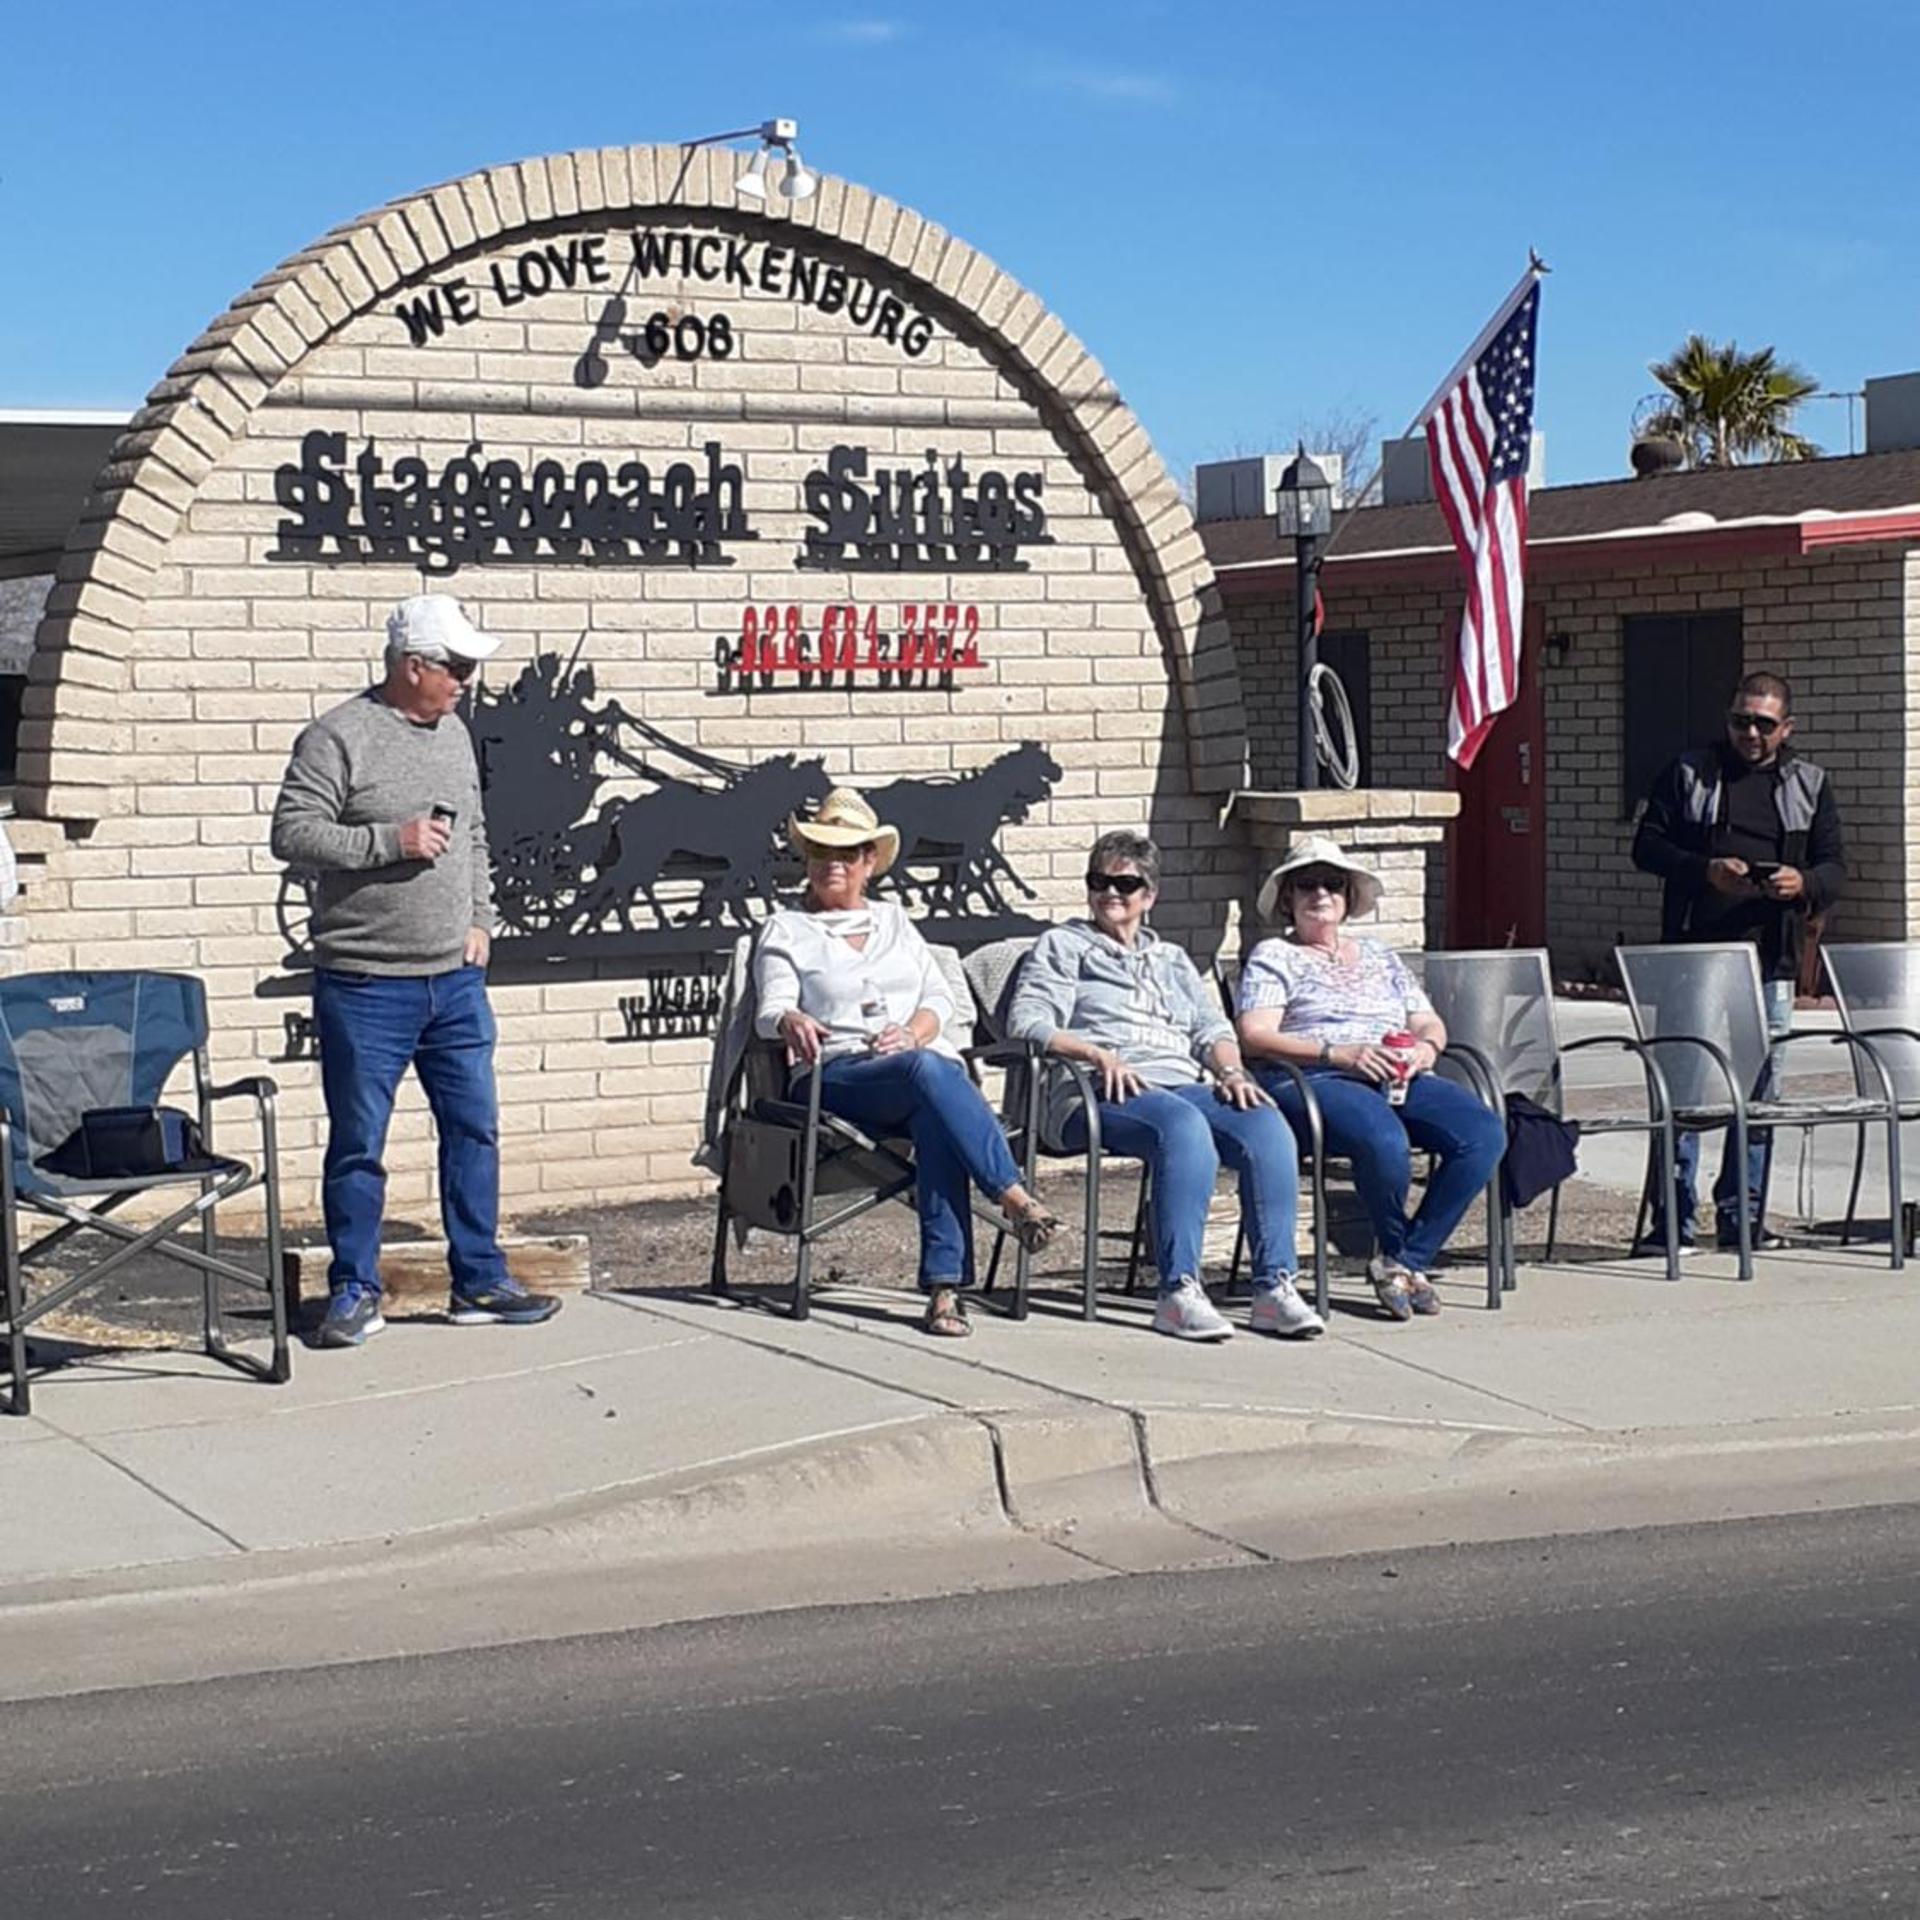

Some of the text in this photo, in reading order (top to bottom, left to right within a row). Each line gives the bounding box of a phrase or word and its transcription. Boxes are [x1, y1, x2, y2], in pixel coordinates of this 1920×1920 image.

[396, 231, 934, 357] WE LOVE WICKENBURG
[644, 312, 734, 361] 608
[284, 430, 1052, 548] Stagecoach Suites
